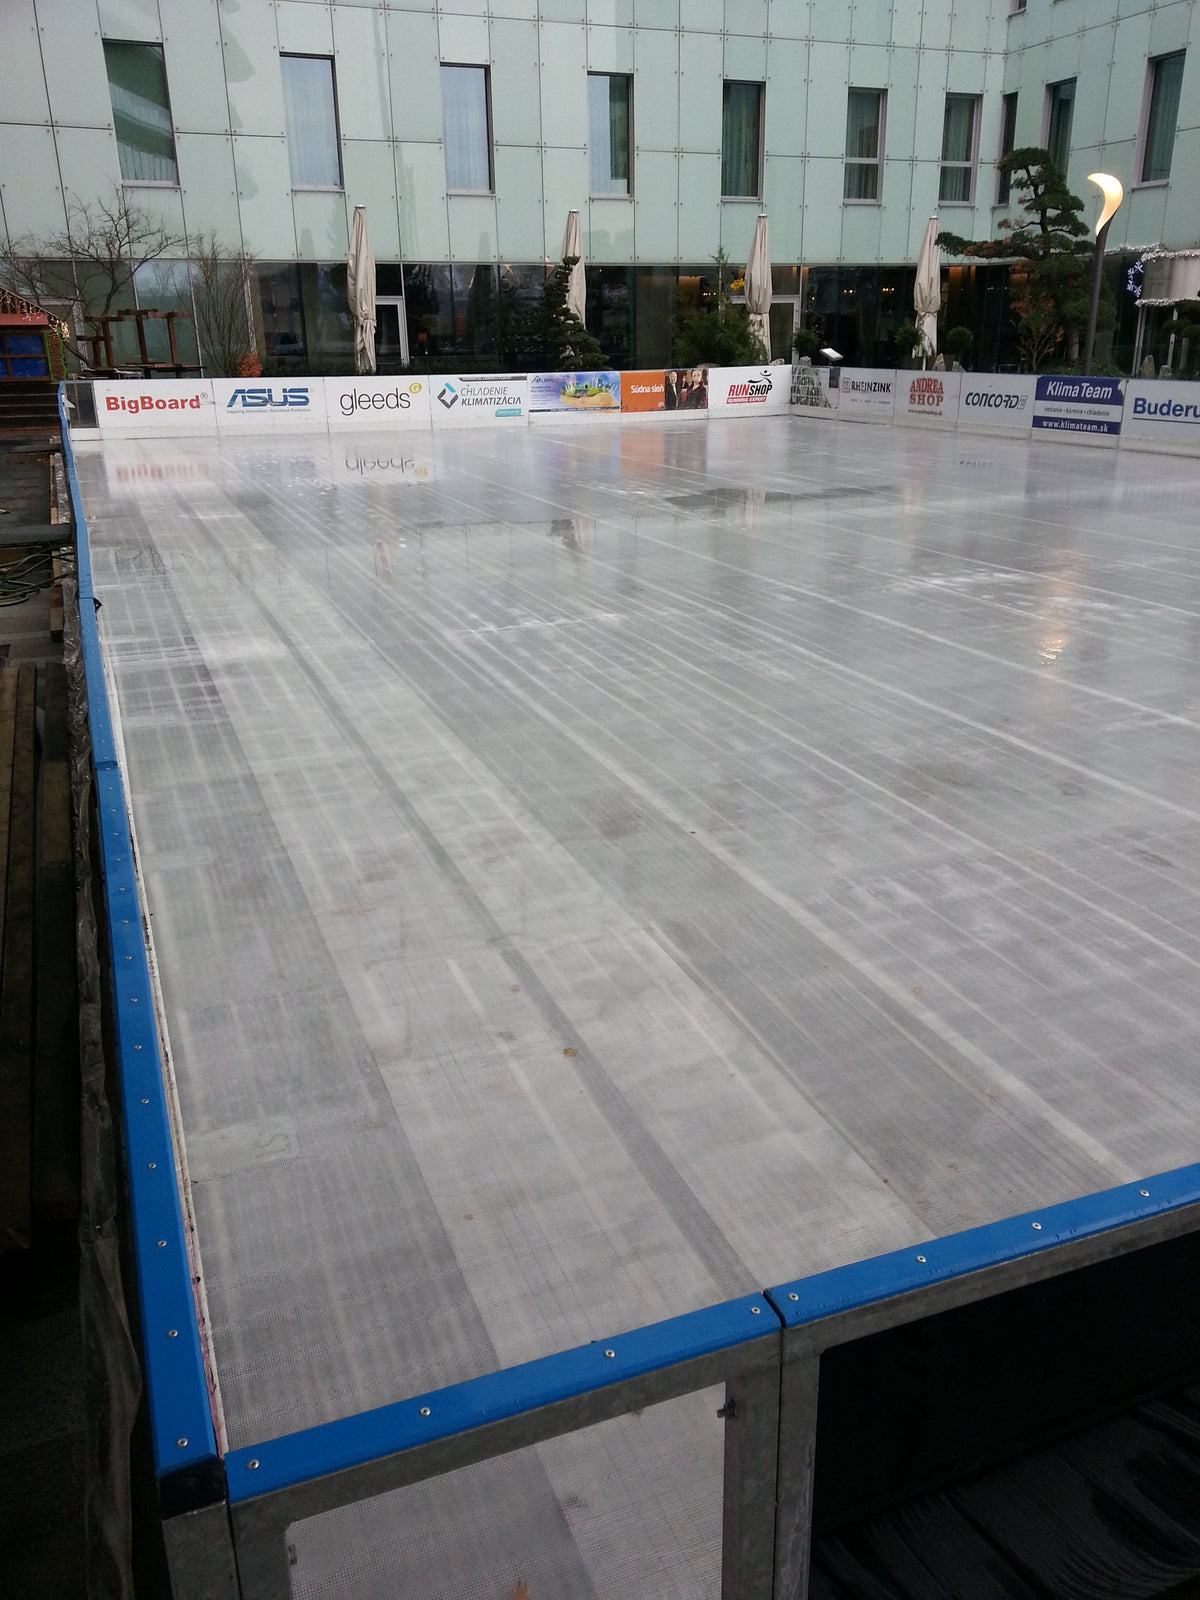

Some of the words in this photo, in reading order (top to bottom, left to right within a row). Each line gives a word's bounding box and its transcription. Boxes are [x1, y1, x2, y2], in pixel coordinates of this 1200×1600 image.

[460, 386, 508, 397] CHLADENIE
[630, 385, 651, 394] Súdna
[851, 381, 892, 393] RHEINZINK
[909, 377, 944, 394] ANDREA
[226, 387, 310, 407] ASUS
[340, 388, 411, 416] gleeds
[461, 396, 522, 406] KLIMATIZÁCIA
[909, 393, 944, 407] SHOP
[965, 392, 1028, 410] CONCORDE
[105, 395, 201, 414] BigBoard
[1042, 420, 1109, 433] www.klimateam.sk
